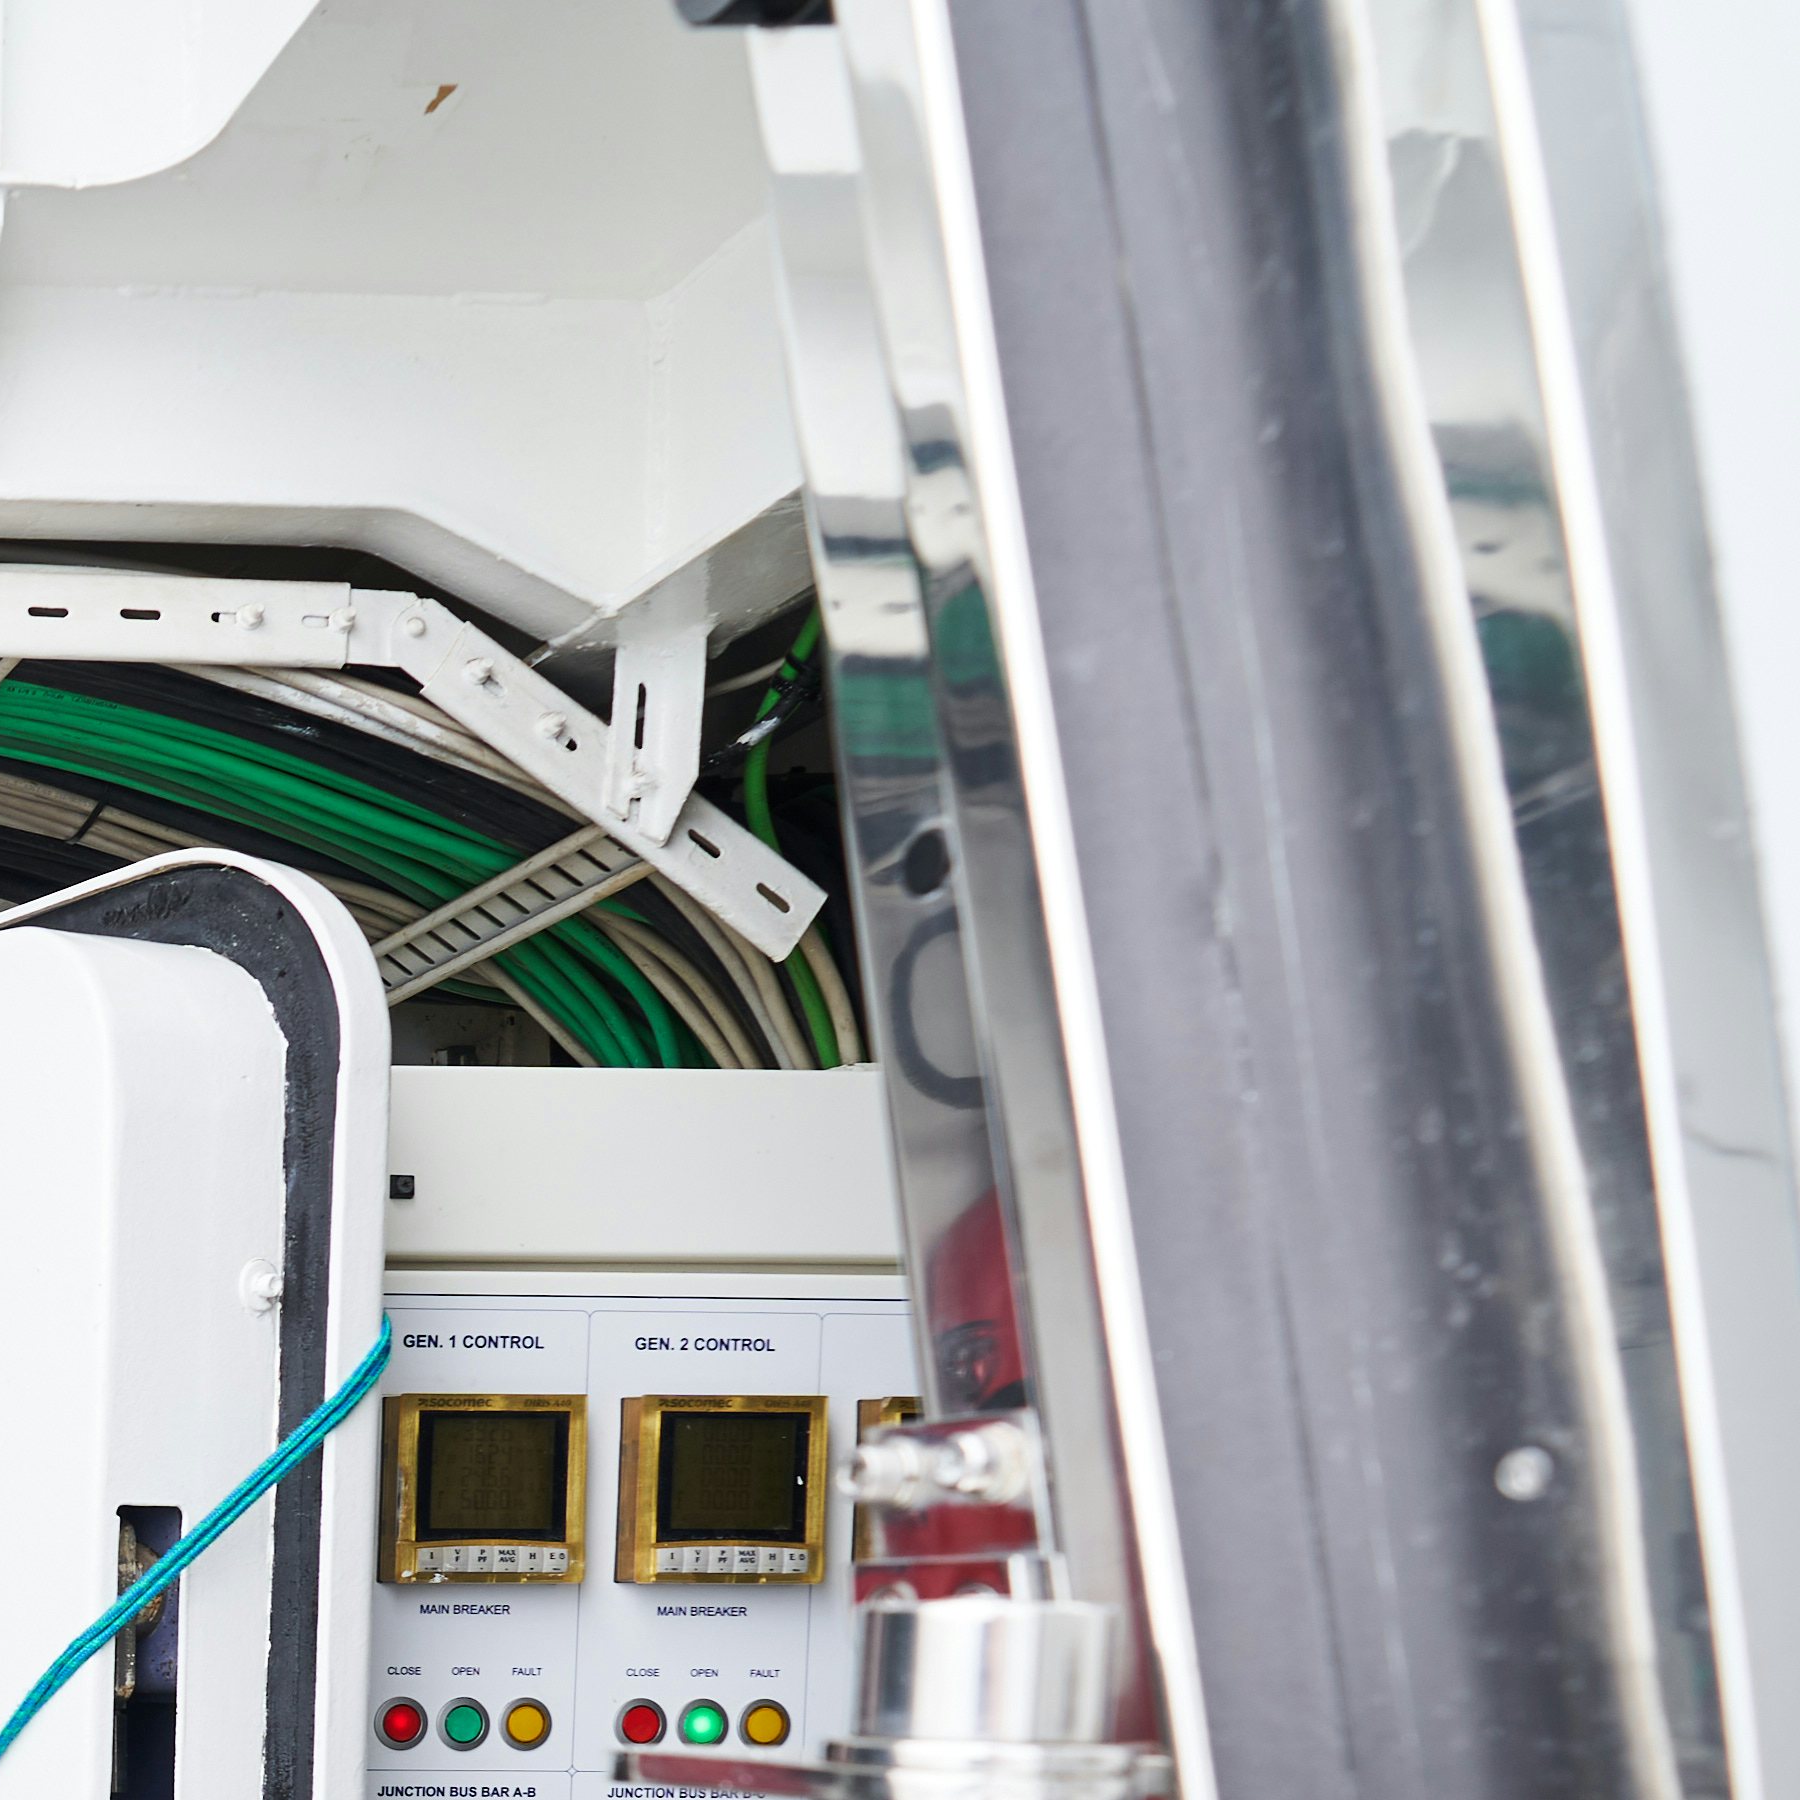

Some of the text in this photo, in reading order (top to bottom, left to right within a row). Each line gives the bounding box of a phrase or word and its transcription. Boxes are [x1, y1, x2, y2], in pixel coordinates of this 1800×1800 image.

[402, 1334, 545, 1350] GEN. 1 CONTROL
[634, 1336, 776, 1352] GEN. 2 CONTROL
[419, 1604, 511, 1615] MAIN BREAKER
[657, 1606, 748, 1617] MAIN BREAKER
[387, 1666, 422, 1676] CLOSE
[451, 1666, 480, 1676] OPEN
[511, 1667, 543, 1677] FAULT
[626, 1668, 660, 1678] CLOSE
[690, 1668, 719, 1678] OPEN
[749, 1668, 781, 1678] FAULT
[377, 1785, 537, 1798] JUNCTION BUS BAR A-B
